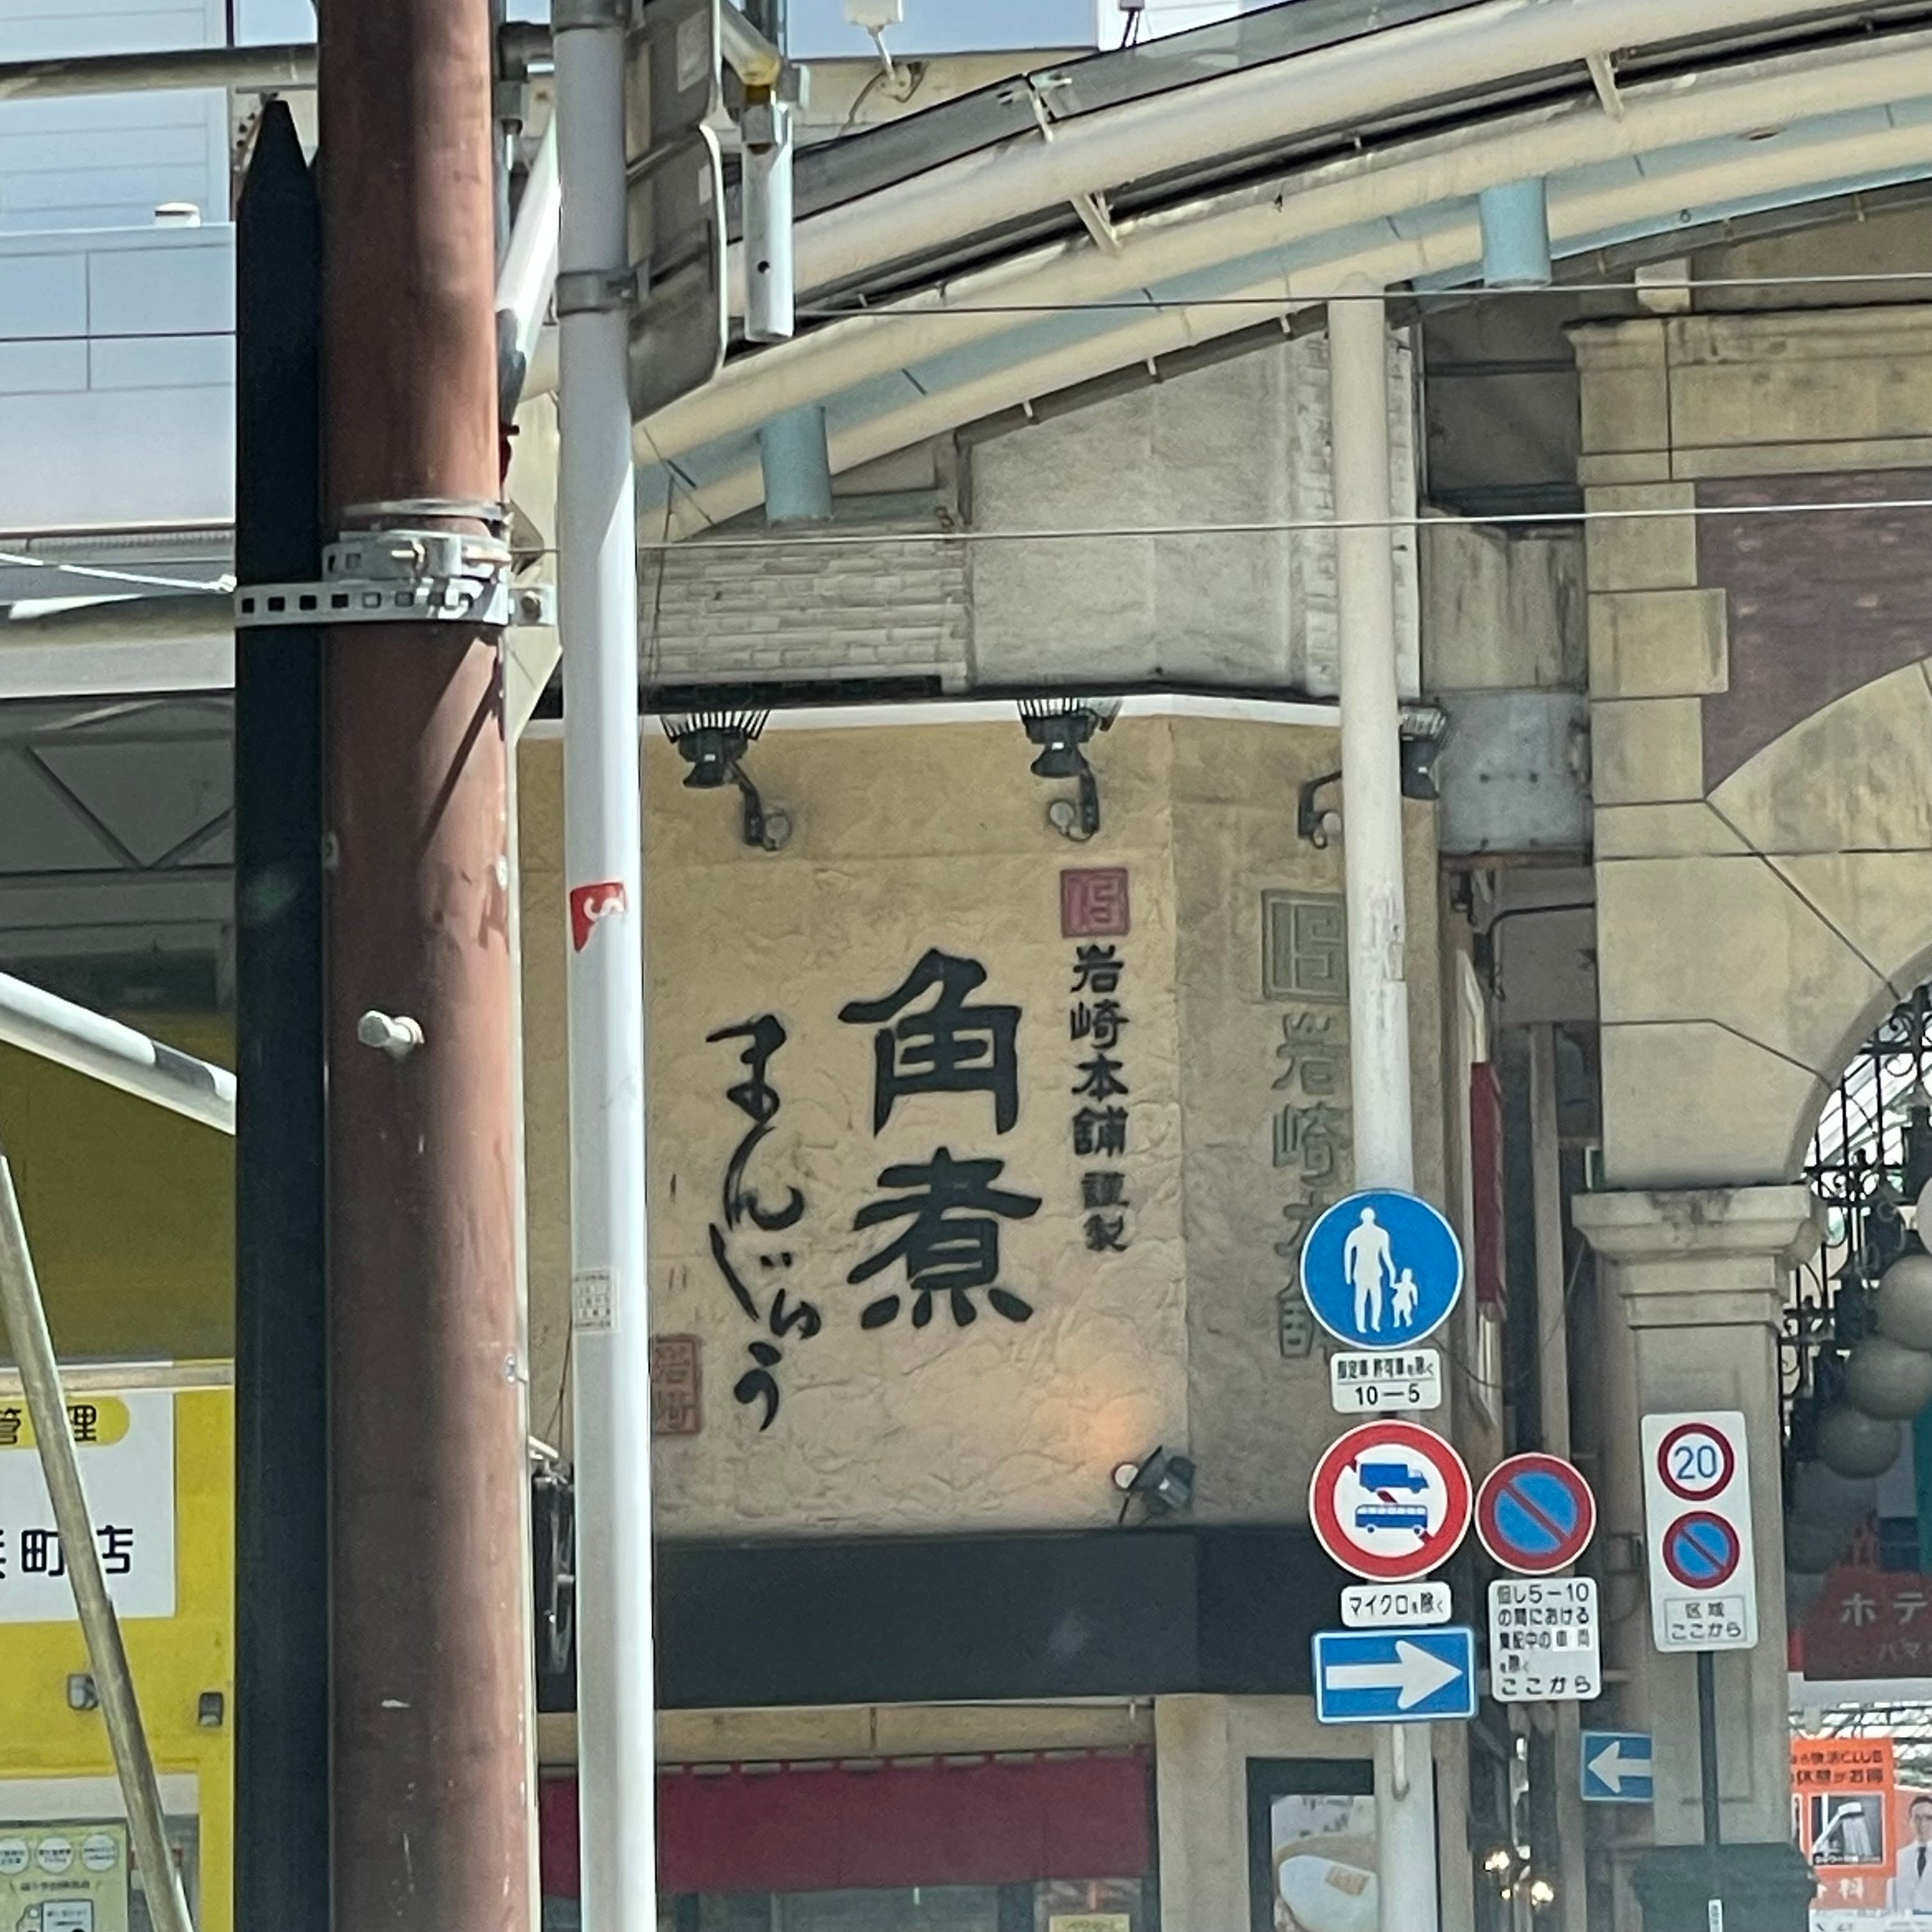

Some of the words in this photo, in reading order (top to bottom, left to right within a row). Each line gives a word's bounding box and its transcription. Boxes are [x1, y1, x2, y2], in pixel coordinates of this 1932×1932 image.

[838, 947, 1042, 1330] 角煮
[706, 1014, 822, 1431] まんじゅう
[1675, 1445, 1717, 1480] 20
[0, 1525, 133, 1579] 町店
[1685, 1602, 1724, 1619] 区域
[1672, 1621, 1742, 1640] ここから
[1502, 1676, 1591, 1695] ここから
